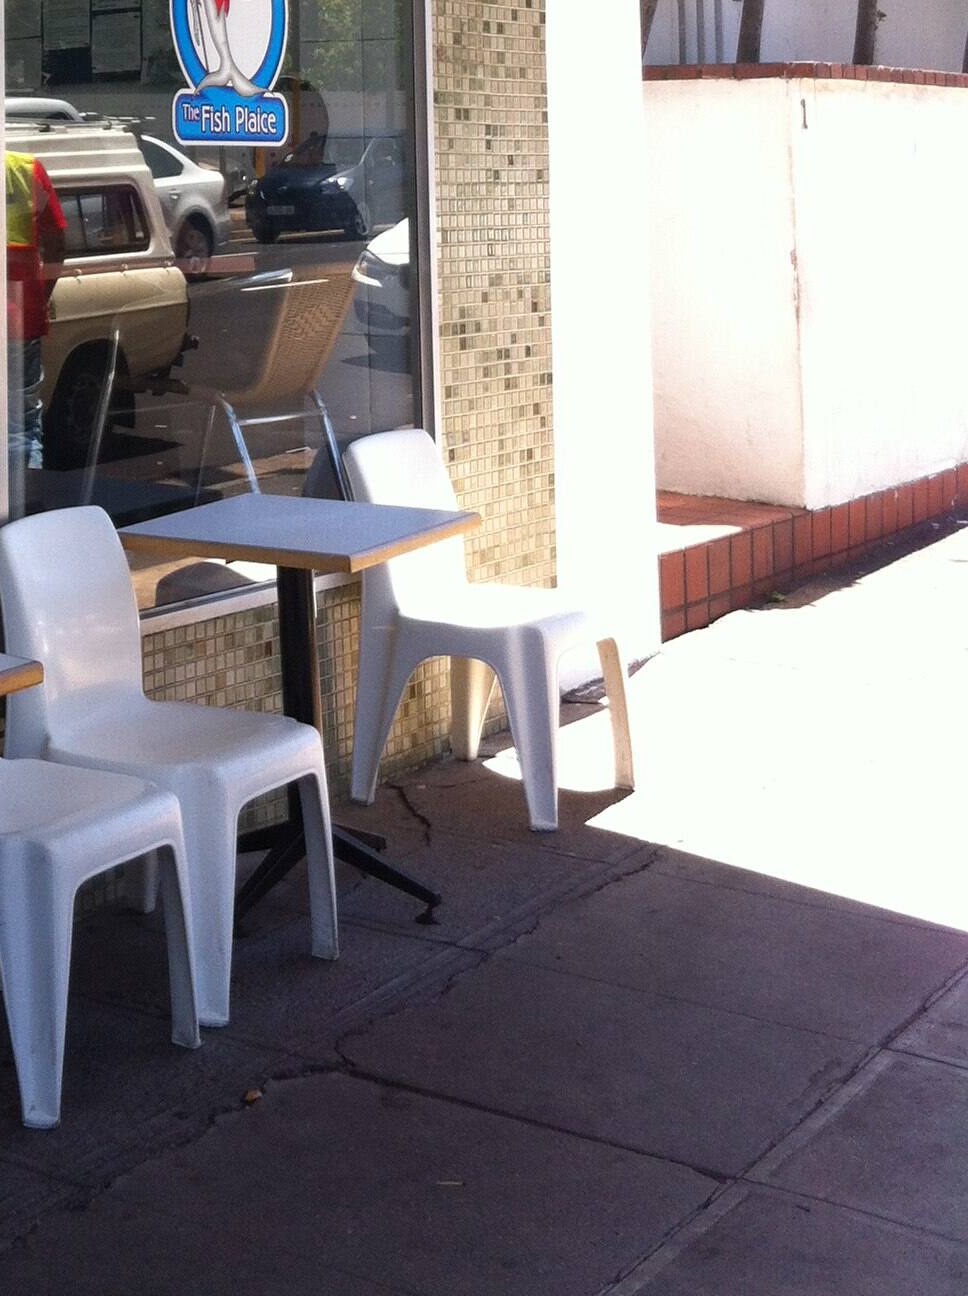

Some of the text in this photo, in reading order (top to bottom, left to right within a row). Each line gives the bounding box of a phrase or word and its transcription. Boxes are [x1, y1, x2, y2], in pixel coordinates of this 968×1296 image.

[182, 103, 277, 134] The Fish Plaice
